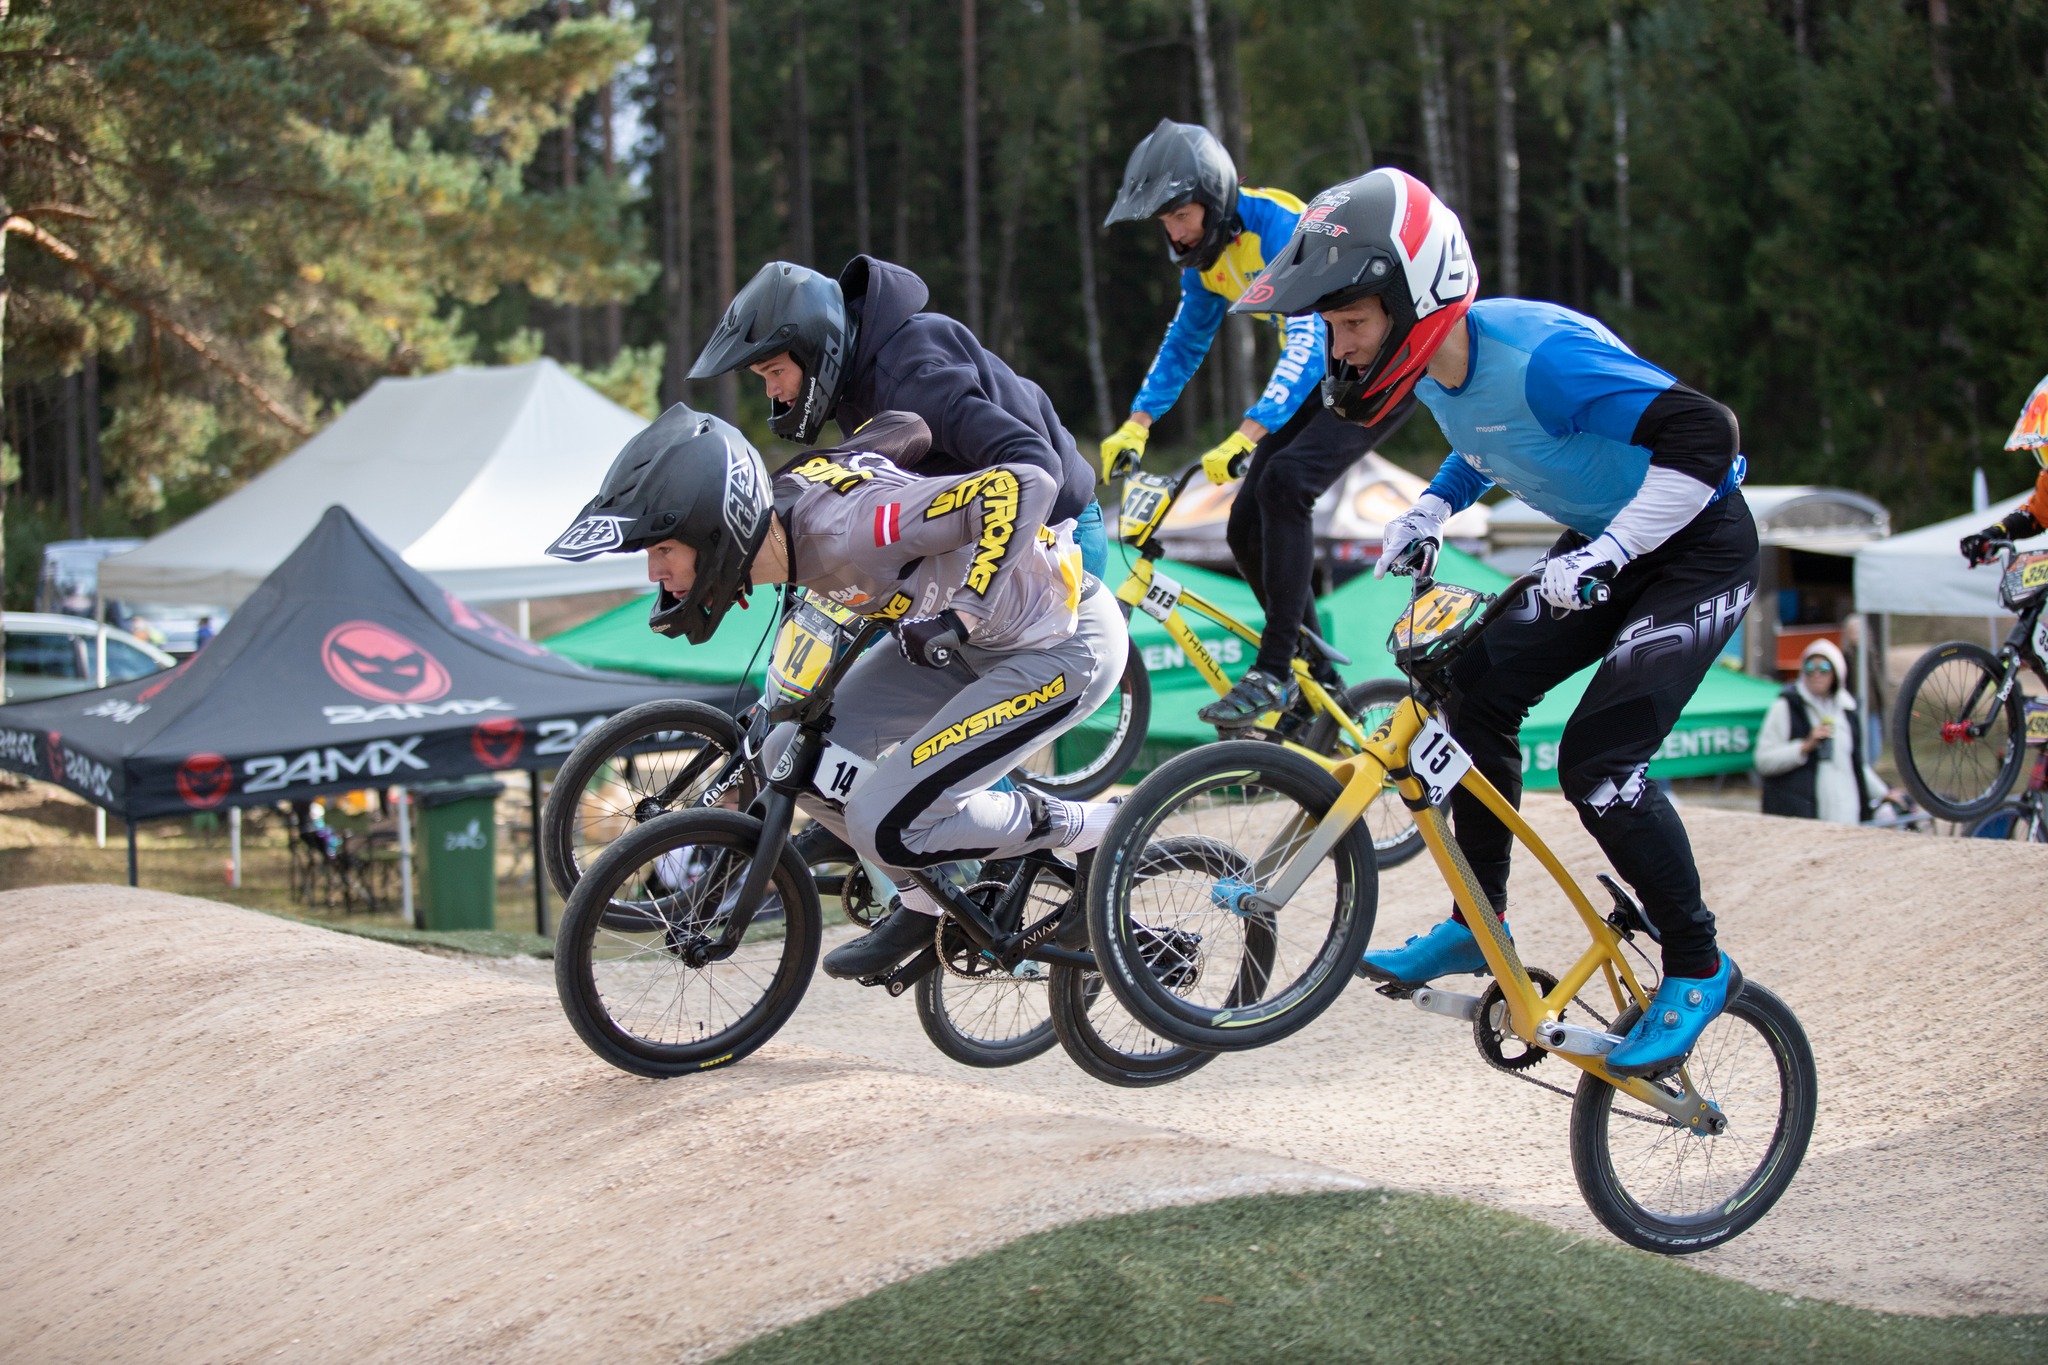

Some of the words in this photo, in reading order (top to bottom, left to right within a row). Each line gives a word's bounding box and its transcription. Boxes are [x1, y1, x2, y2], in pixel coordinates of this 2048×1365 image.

[1264, 314, 1315, 405] TSPILS
[1146, 585, 1177, 610] 613
[1414, 594, 1462, 631] 15
[782, 632, 816, 680] 14
[1145, 637, 1243, 671] ENRS
[1182, 625, 1222, 682] THRILL
[322, 696, 516, 725] 24MX
[912, 673, 1066, 768] STAYSTRONG
[241, 735, 430, 794] 24MX
[1420, 731, 1458, 775] 15
[830, 761, 859, 798] 14
